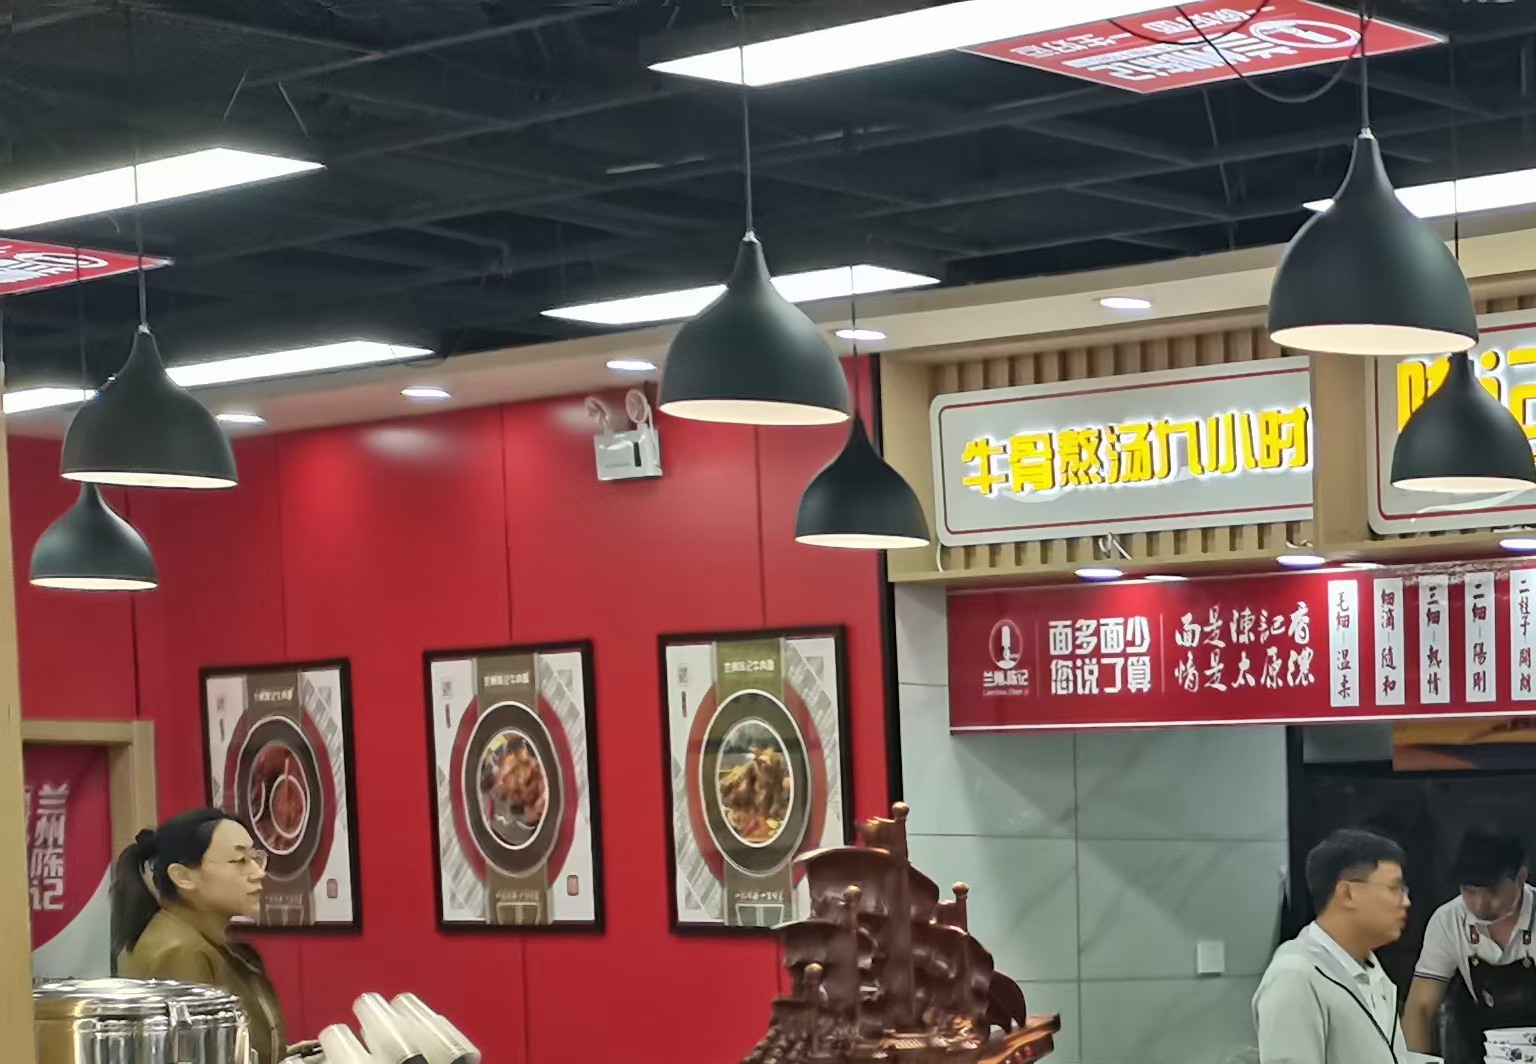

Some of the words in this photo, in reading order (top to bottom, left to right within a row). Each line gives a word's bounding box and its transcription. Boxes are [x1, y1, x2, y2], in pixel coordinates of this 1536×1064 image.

[962, 406, 1313, 496] 牛骨熬汤九小时
[1049, 615, 1150, 656] 面多面少
[1050, 656, 1151, 695] 您说了算
[29, 782, 69, 910] 兰州陈记
